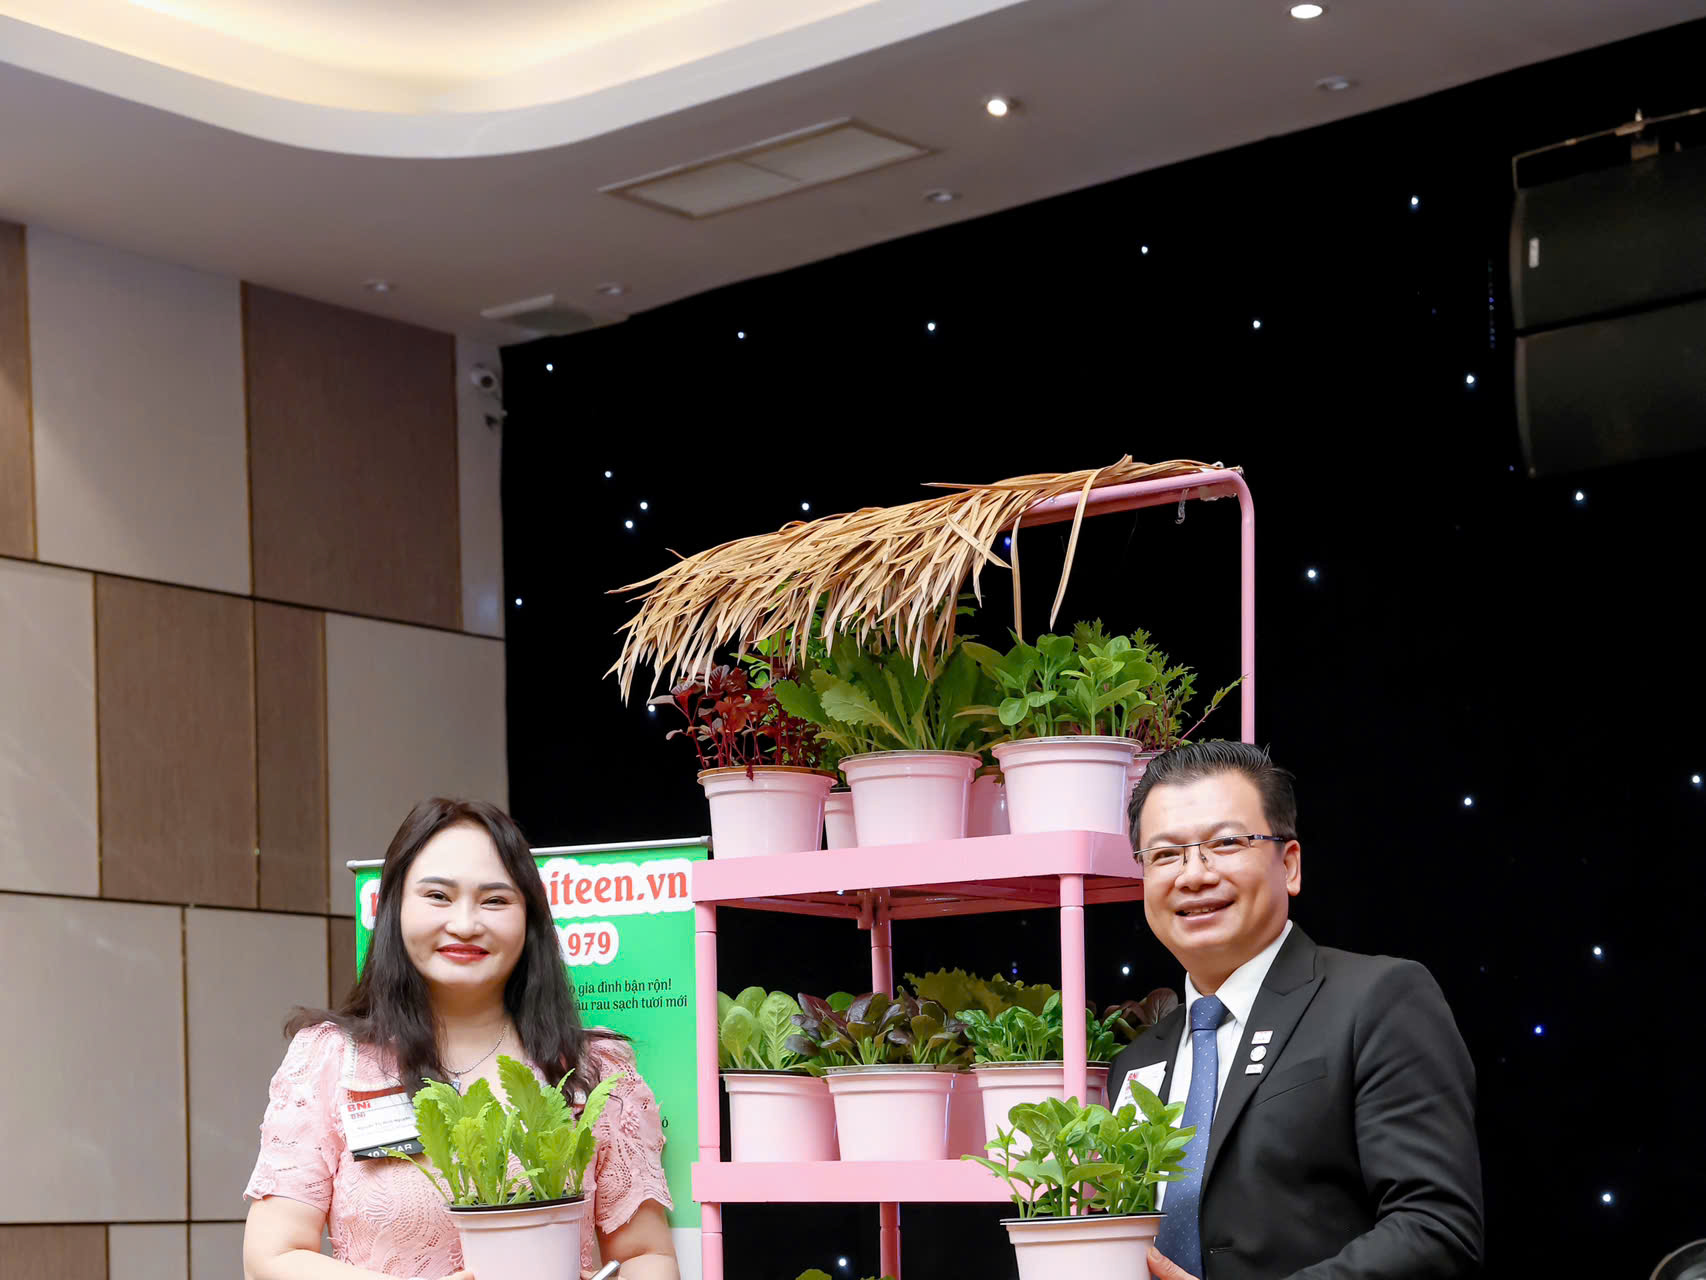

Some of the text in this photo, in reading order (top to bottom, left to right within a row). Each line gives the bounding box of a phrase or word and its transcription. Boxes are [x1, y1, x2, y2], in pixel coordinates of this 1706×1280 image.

[543, 871, 688, 906] iteen.vn
[568, 931, 611, 957] 979
[578, 981, 595, 998] gia
[597, 980, 622, 994] đình
[624, 979, 646, 995] bận
[648, 977, 672, 994] rộn!
[591, 1001, 611, 1011] rau
[612, 997, 639, 1012] sạch
[641, 996, 663, 1009] tươi
[665, 994, 688, 1008] mới
